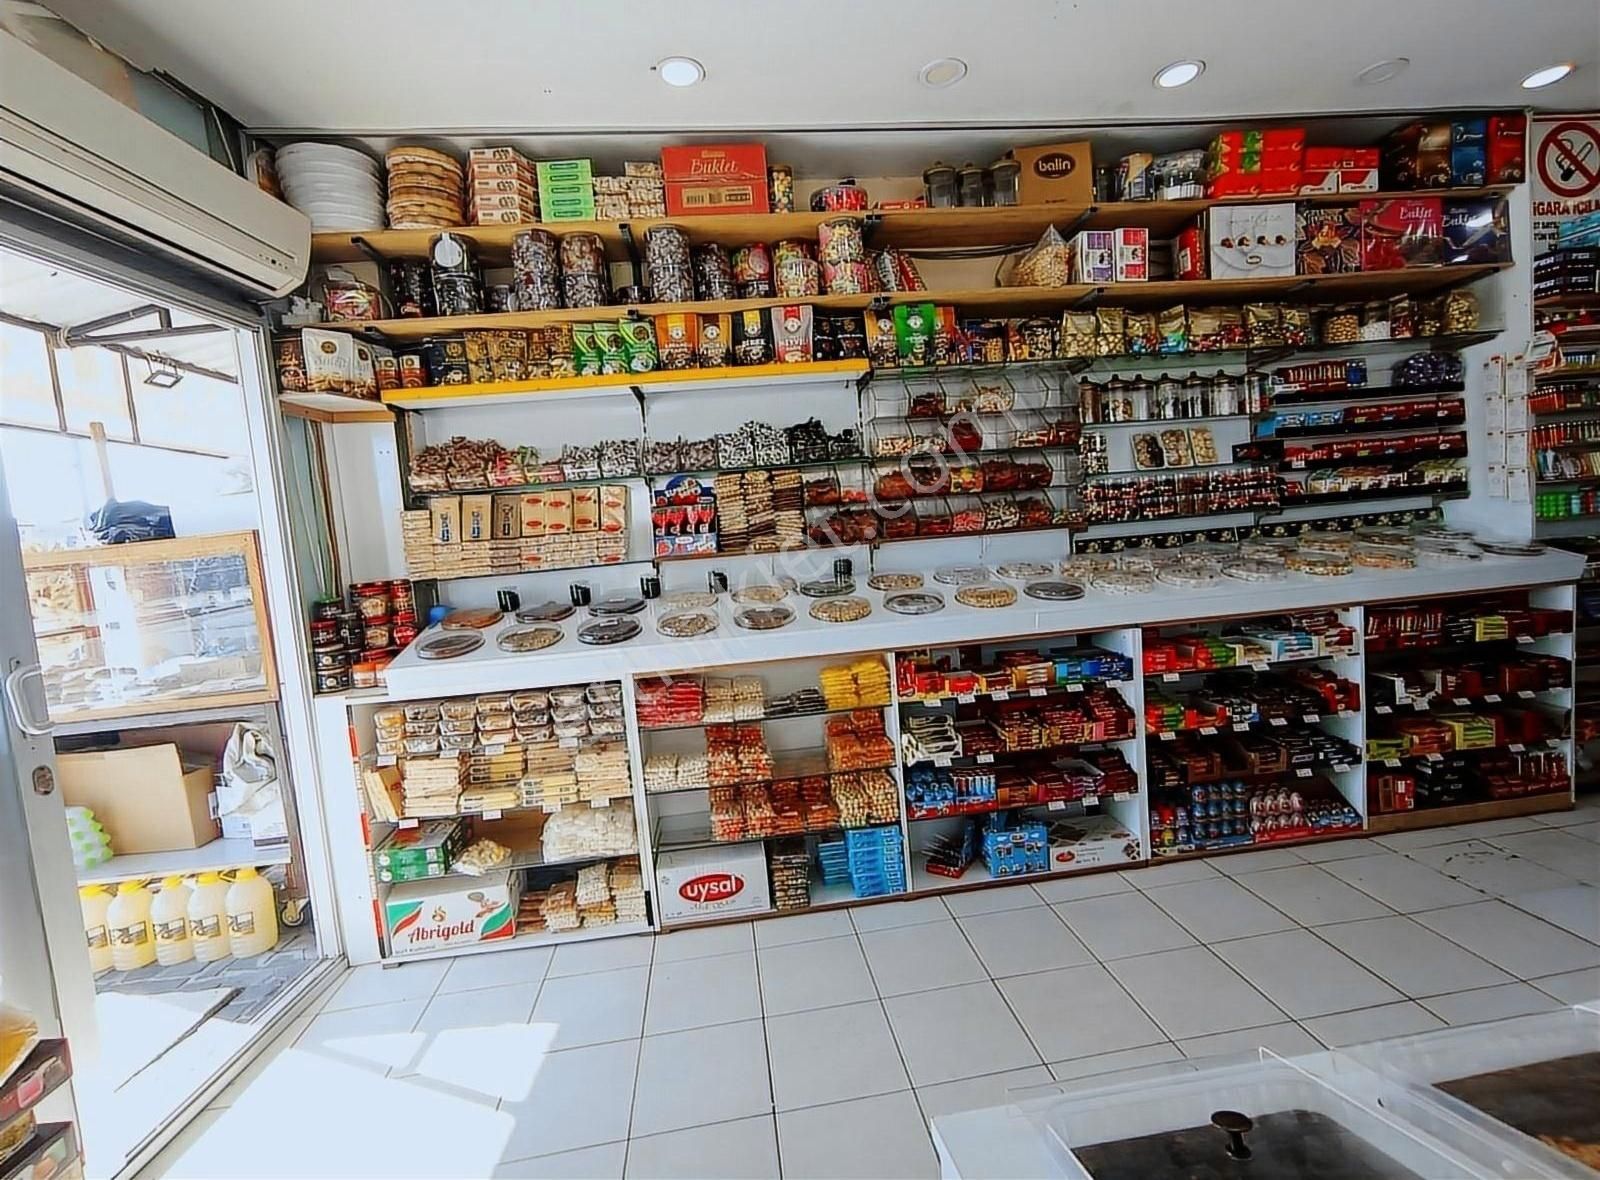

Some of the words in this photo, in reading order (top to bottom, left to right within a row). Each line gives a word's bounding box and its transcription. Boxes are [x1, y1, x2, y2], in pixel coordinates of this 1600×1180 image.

[1038, 158, 1071, 172] balin
[686, 875, 736, 902] uysal
[408, 919, 474, 943] Abrigold
